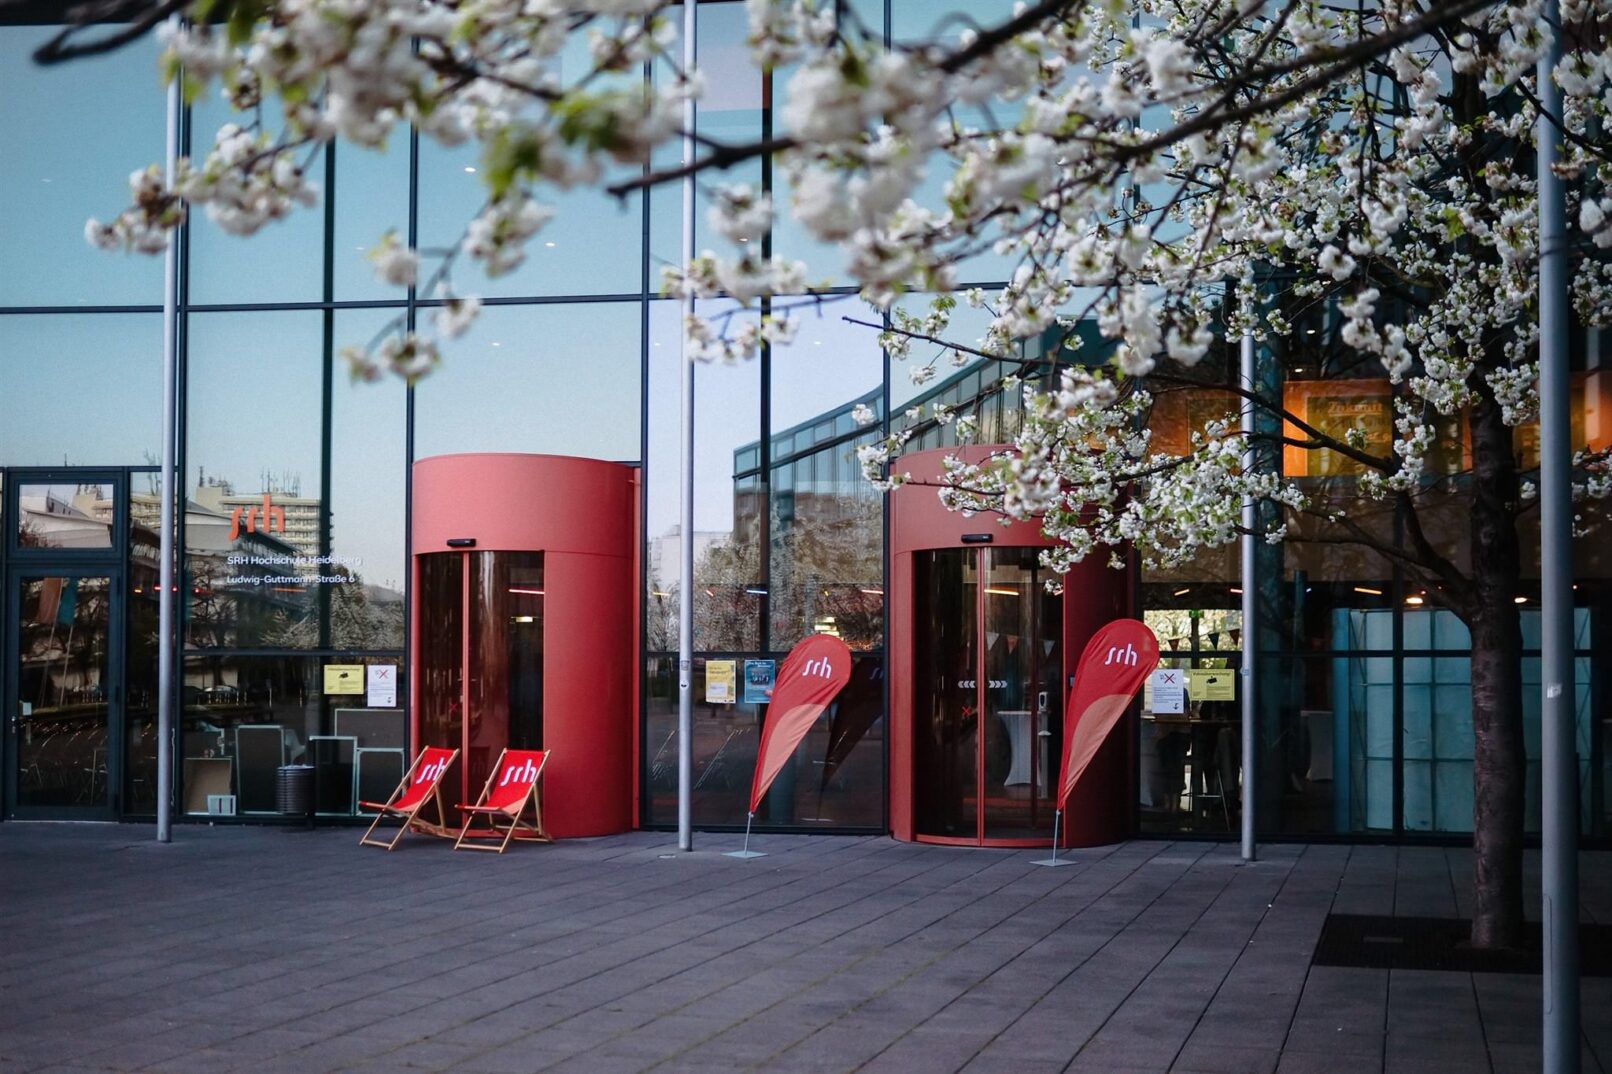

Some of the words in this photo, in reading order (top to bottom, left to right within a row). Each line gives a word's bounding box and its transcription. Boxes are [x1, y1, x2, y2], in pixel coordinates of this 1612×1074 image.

[228, 494, 285, 540] srh
[227, 556, 249, 565] SRH
[250, 555, 307, 565] Hochschule
[308, 556, 362, 566] Heidelberg
[1104, 643, 1137, 666] srh
[802, 656, 832, 679] srh
[415, 756, 447, 784] srh
[500, 758, 537, 786] srh
